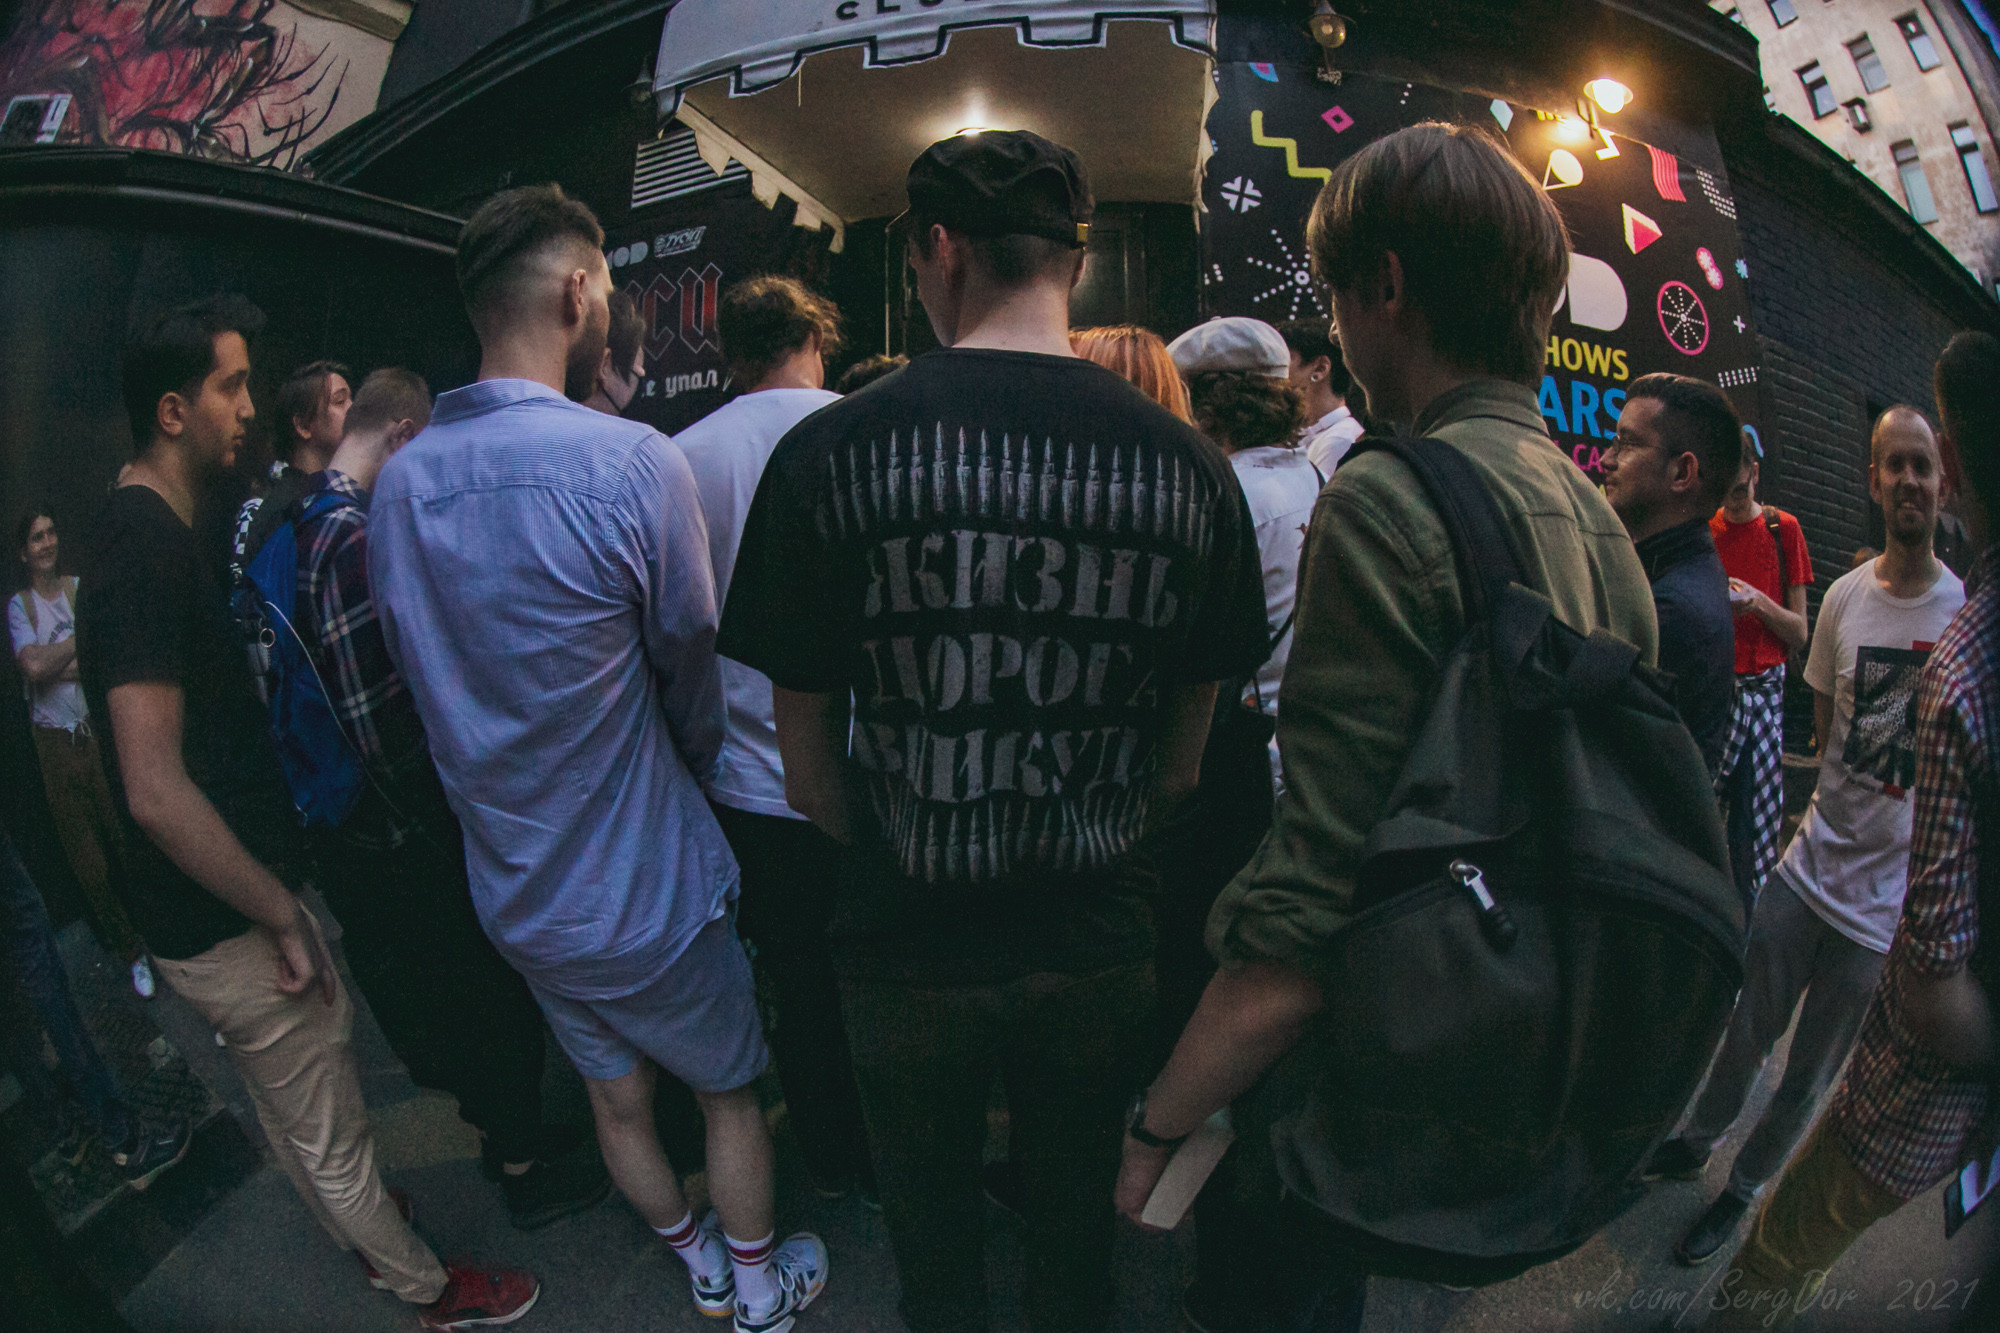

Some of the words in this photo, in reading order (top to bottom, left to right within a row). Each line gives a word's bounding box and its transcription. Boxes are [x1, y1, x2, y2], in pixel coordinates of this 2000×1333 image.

[835, 0, 986, 21] CL
[1544, 335, 1630, 382] HOWS
[1537, 375, 1627, 441] ARS
[1572, 443, 1609, 474] CA
[864, 528, 1180, 627] ЖИЗНЬ
